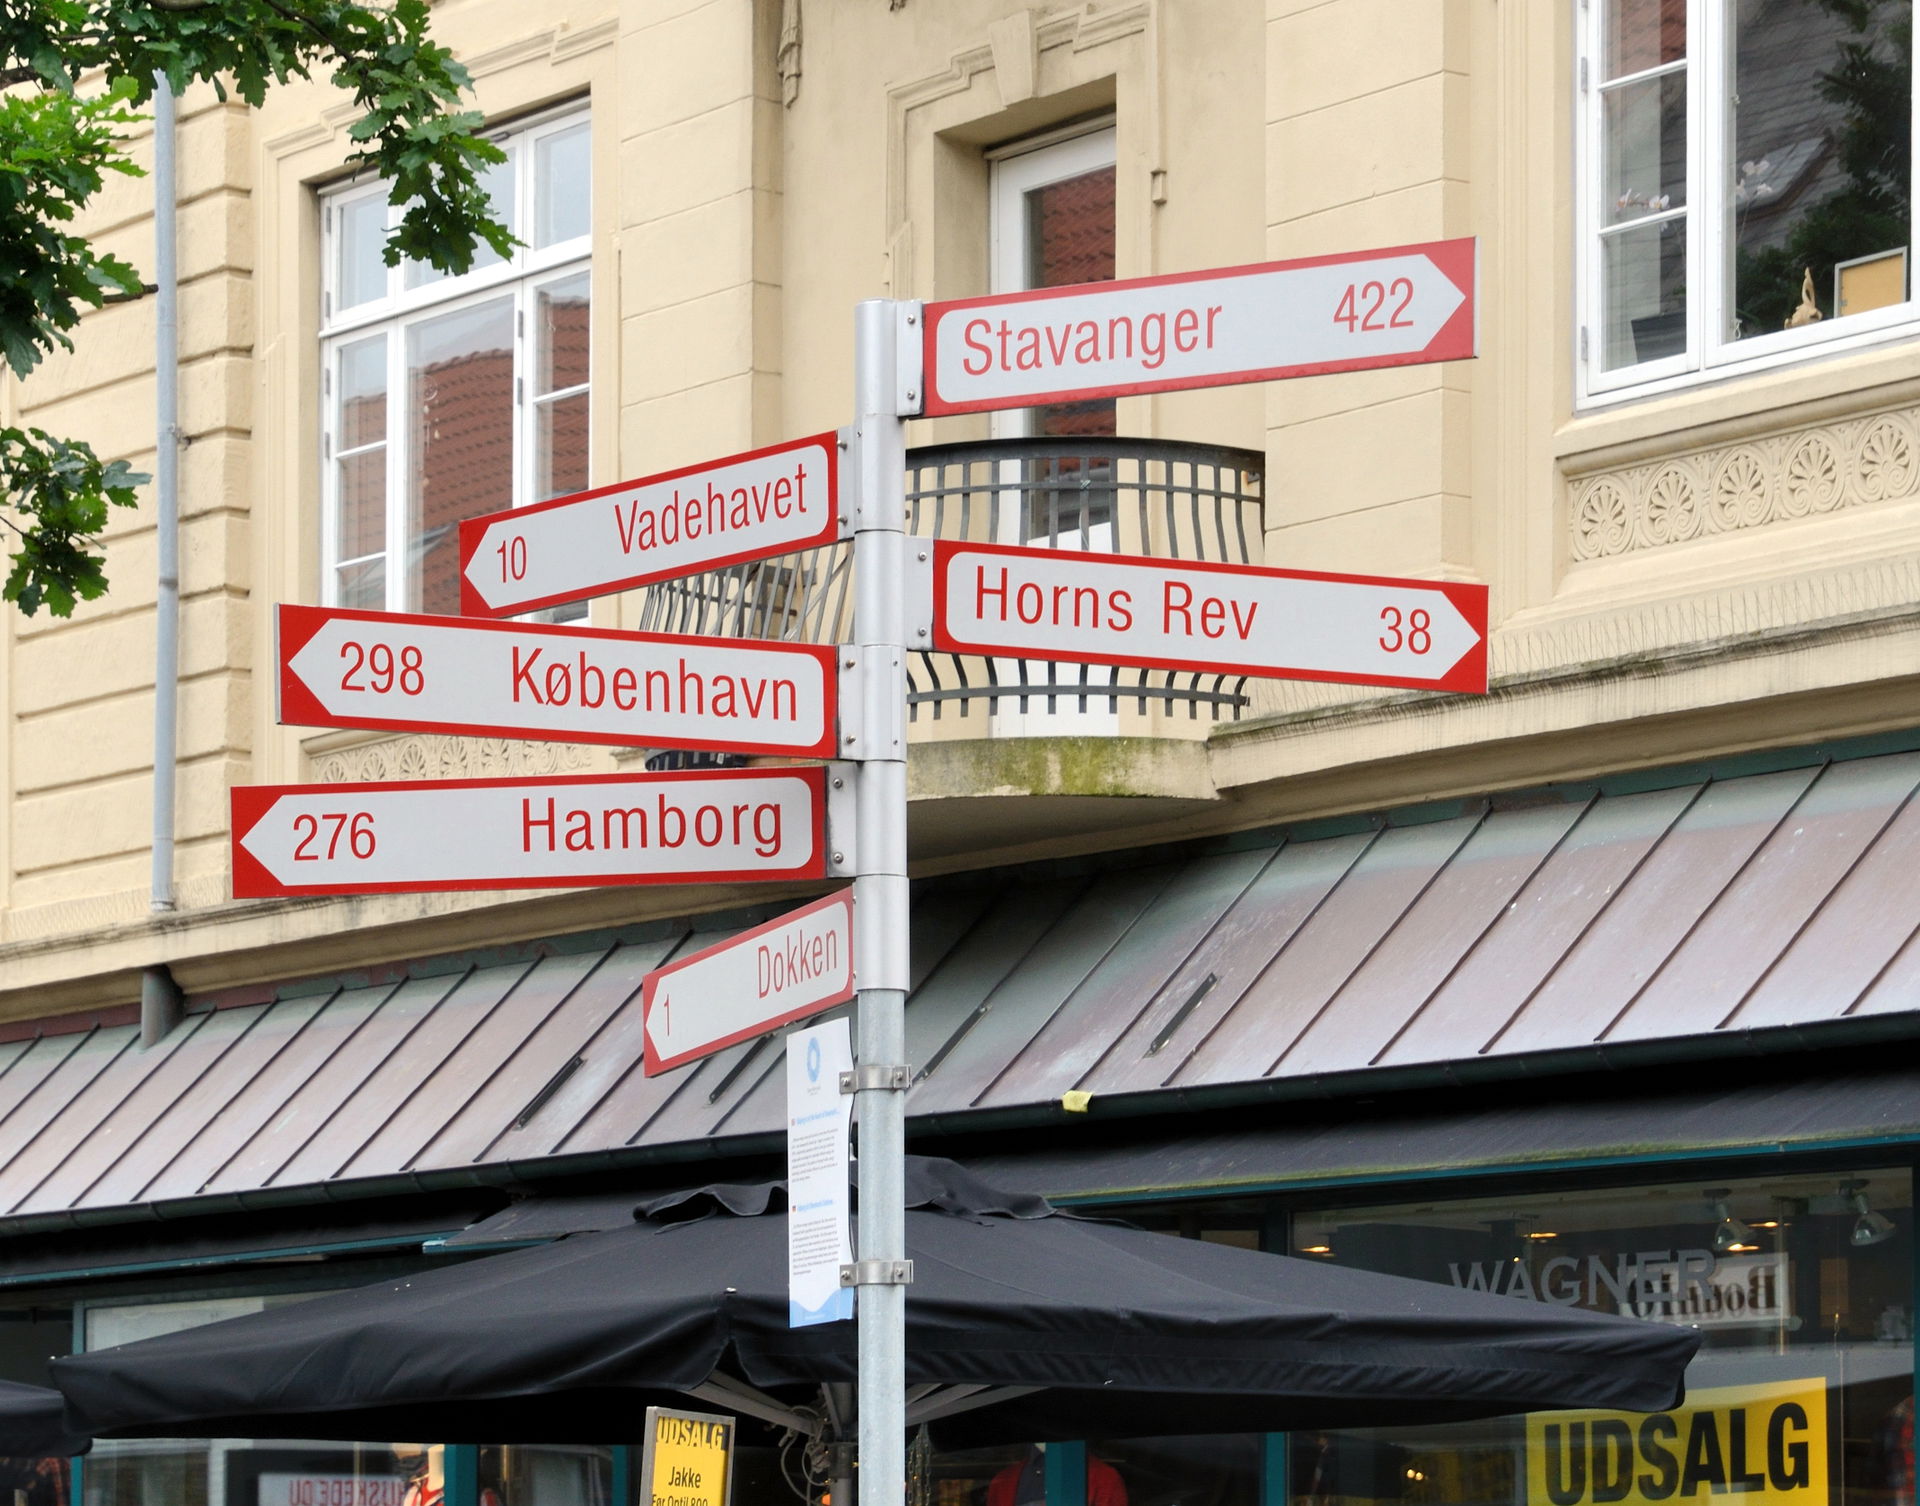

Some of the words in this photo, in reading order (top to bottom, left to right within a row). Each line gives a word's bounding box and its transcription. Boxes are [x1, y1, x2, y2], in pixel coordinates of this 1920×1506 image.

[963, 306, 1222, 376] Stavanger
[1333, 278, 1414, 332] 422
[497, 536, 527, 583] 10
[614, 464, 807, 554] Vadehavet
[976, 565, 1133, 632] Horns
[1162, 580, 1258, 640] Rev
[1379, 606, 1432, 655] 38
[340, 641, 425, 696] 298
[512, 646, 797, 721] København
[293, 812, 376, 861] 276
[522, 793, 782, 858] Hamborg
[663, 994, 670, 1036] 1
[758, 929, 838, 999] Dokken
[1448, 1249, 1717, 1308] WAGNER
[656, 1416, 724, 1450] UDSALG
[1544, 1402, 1810, 1506] UDSALG
[668, 1466, 702, 1488] Jakke
